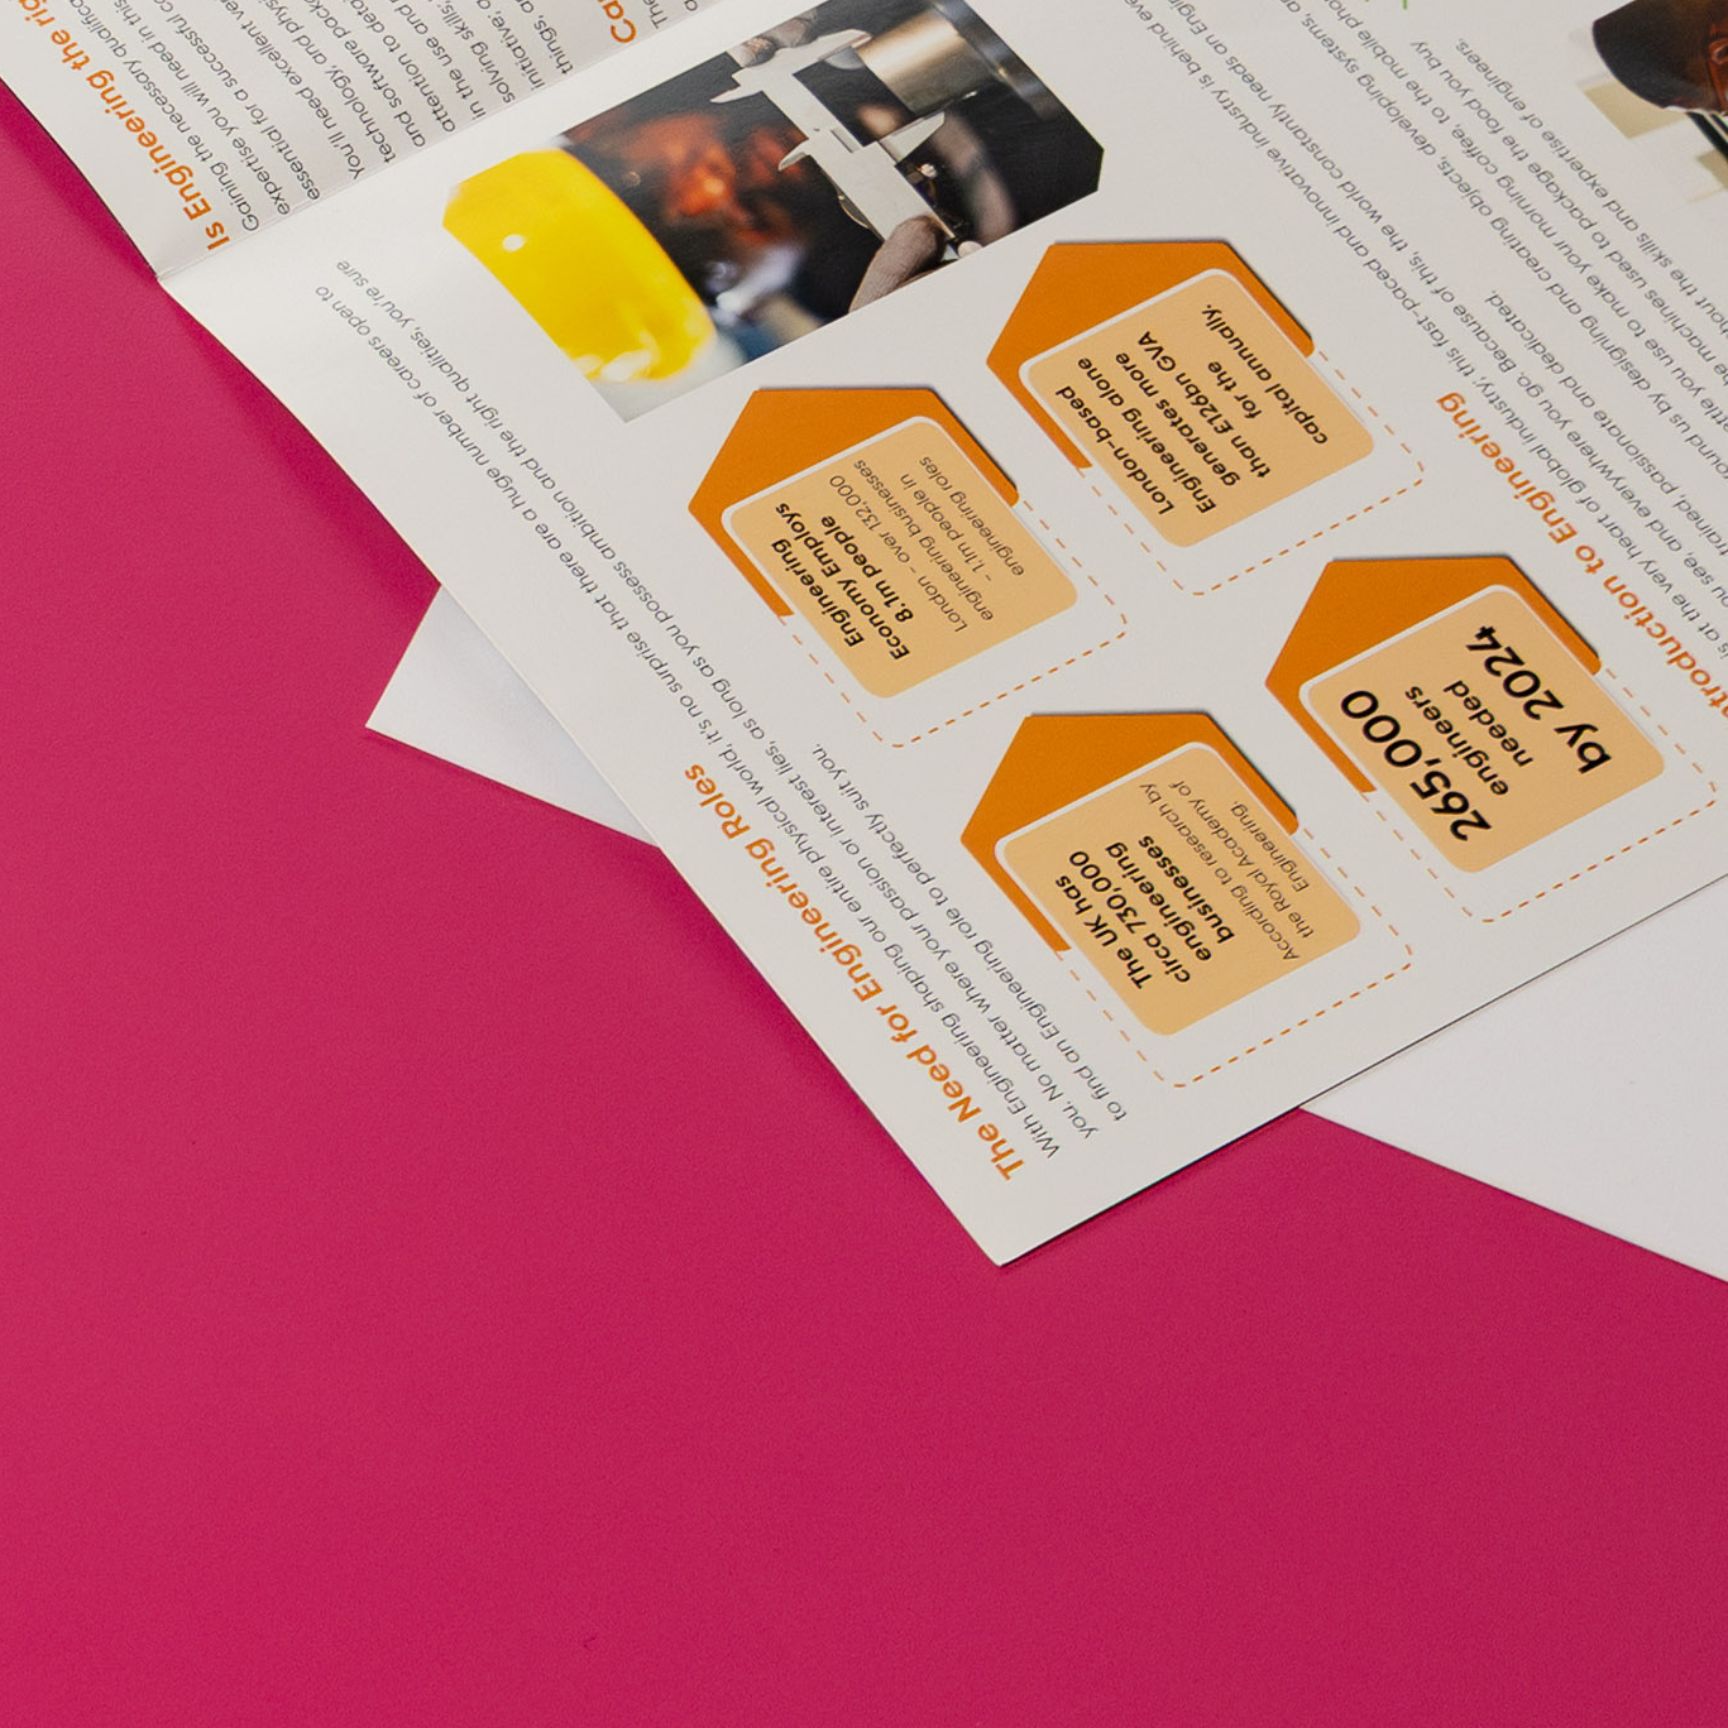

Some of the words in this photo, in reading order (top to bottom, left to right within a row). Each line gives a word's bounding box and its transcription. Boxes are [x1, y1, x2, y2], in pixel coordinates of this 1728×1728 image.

[84, 68, 213, 222] Engineering
[204, 220, 232, 252] Is
[774, 501, 843, 579] Employs
[819, 514, 884, 580] people
[769, 537, 866, 649] Engineering
[835, 578, 912, 661] Economy
[874, 578, 915, 624] 8.1m
[1465, 624, 1566, 722] 2024
[1403, 685, 1510, 797] engineers
[1441, 678, 1535, 768] needed
[1552, 722, 1613, 775] by
[683, 762, 752, 841] Roles
[1339, 689, 1493, 843] 265,000
[743, 836, 885, 1004] Engineering
[1054, 874, 1094, 917] has
[1067, 849, 1148, 935] 730,000
[1104, 840, 1213, 962] engineering
[1137, 834, 1236, 945] businesses
[1082, 913, 1120, 948] UK
[1115, 946, 1154, 991] The
[1142, 931, 1192, 984] circa
[875, 1003, 919, 1044] for
[904, 1043, 983, 1124] Need
[976, 1122, 1026, 1182] The
